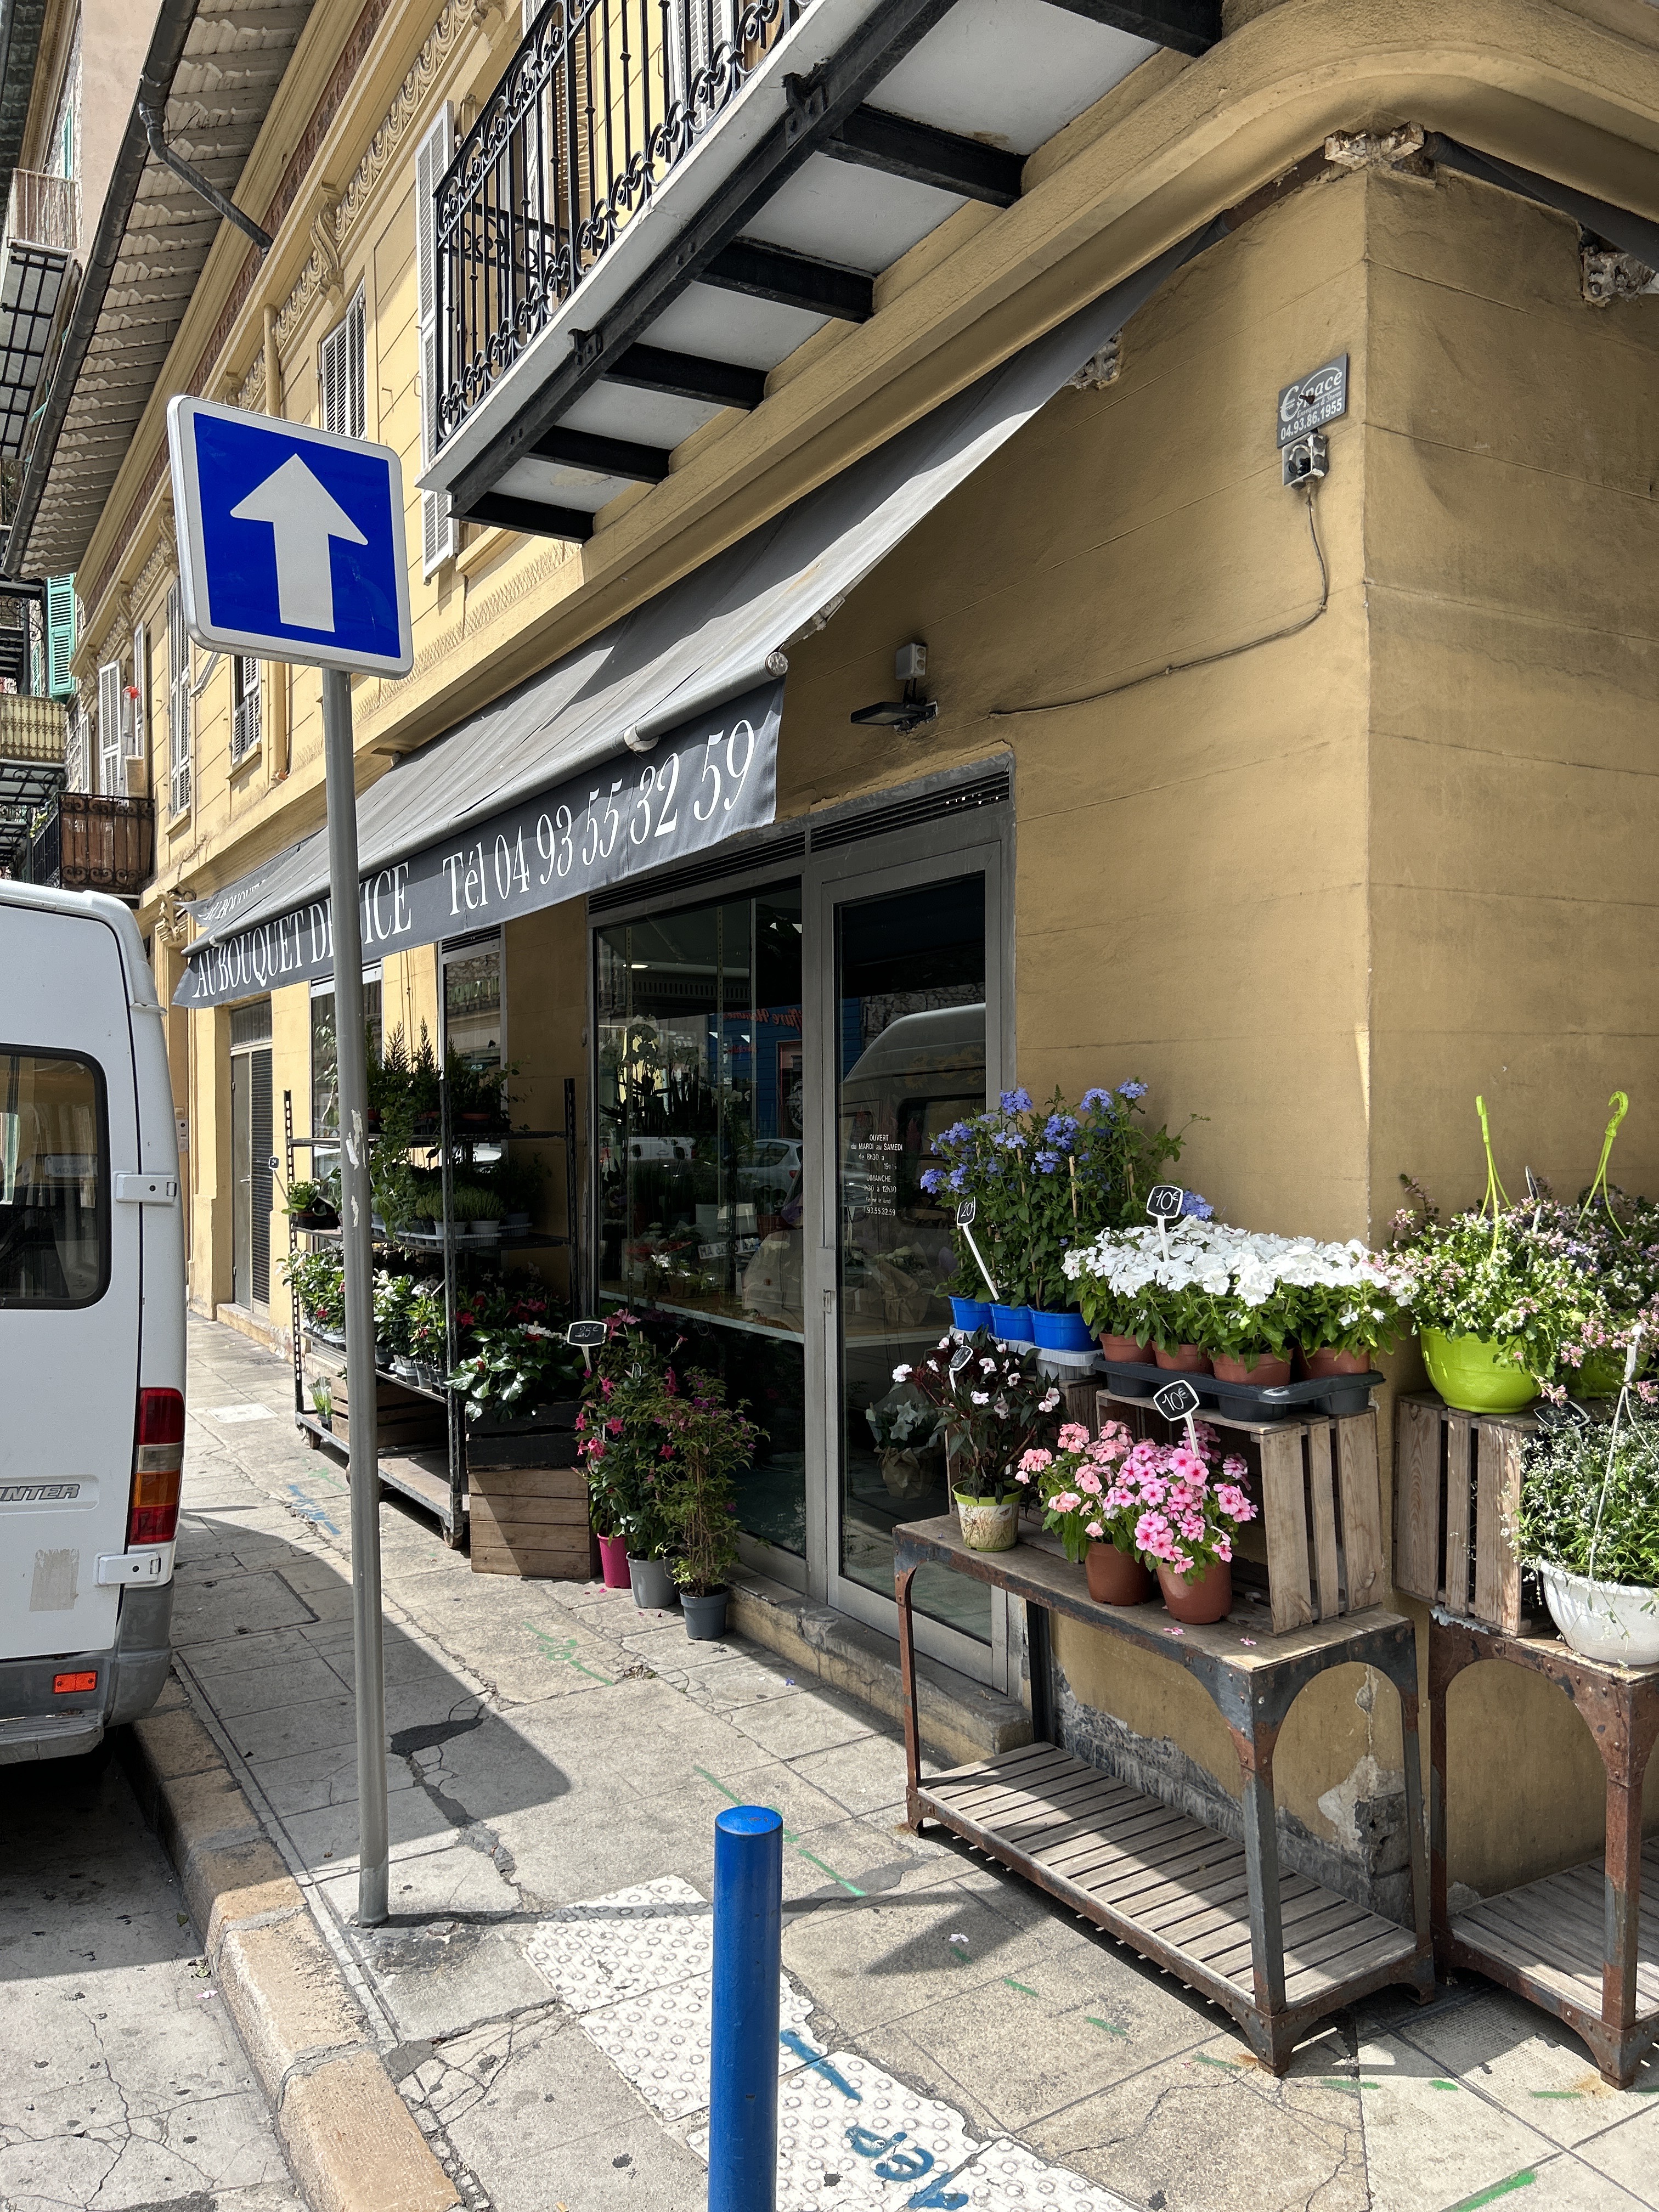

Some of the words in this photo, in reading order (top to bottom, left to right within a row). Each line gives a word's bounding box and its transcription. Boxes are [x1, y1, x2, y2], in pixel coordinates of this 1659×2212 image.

[1280, 397, 1342, 440] 04.93.86.1955
[192, 947, 217, 998] AU
[217, 910, 304, 992] BOUQUET
[308, 898, 334, 963] D
[359, 861, 411, 945] ICE
[442, 842, 489, 916] Tél
[494, 826, 531, 900] 04
[537, 805, 573, 885] 93
[582, 778, 623, 866] 55
[629, 753, 680, 844] 32
[693, 719, 755, 821] 59
[1155, 1189, 1180, 1210] 10€
[574, 1325, 600, 1338] 25€
[1161, 1387, 1188, 1412] 10€
